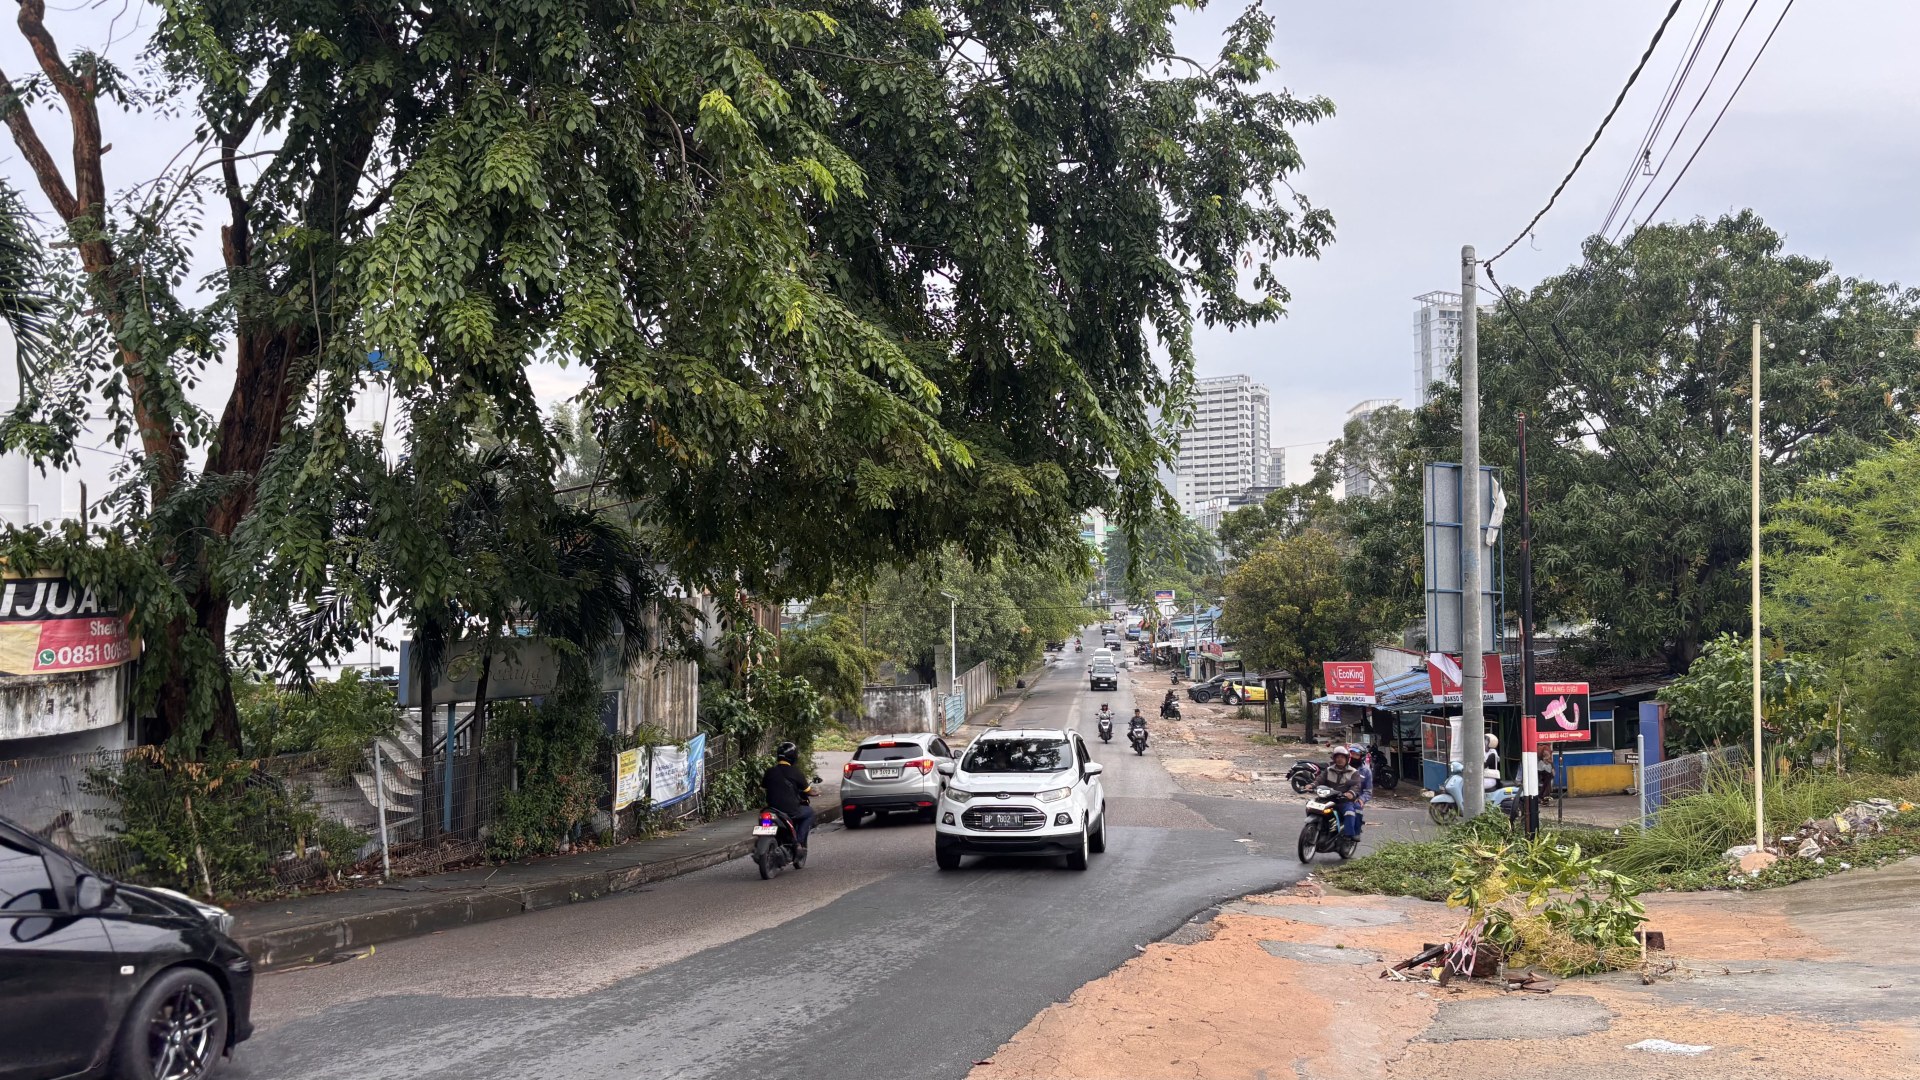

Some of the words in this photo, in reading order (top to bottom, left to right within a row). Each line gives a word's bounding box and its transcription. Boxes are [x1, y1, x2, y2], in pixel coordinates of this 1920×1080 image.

[58, 644, 100, 665] 0851
[1338, 668, 1363, 681] EcoKing
[985, 815, 993, 823] BP
